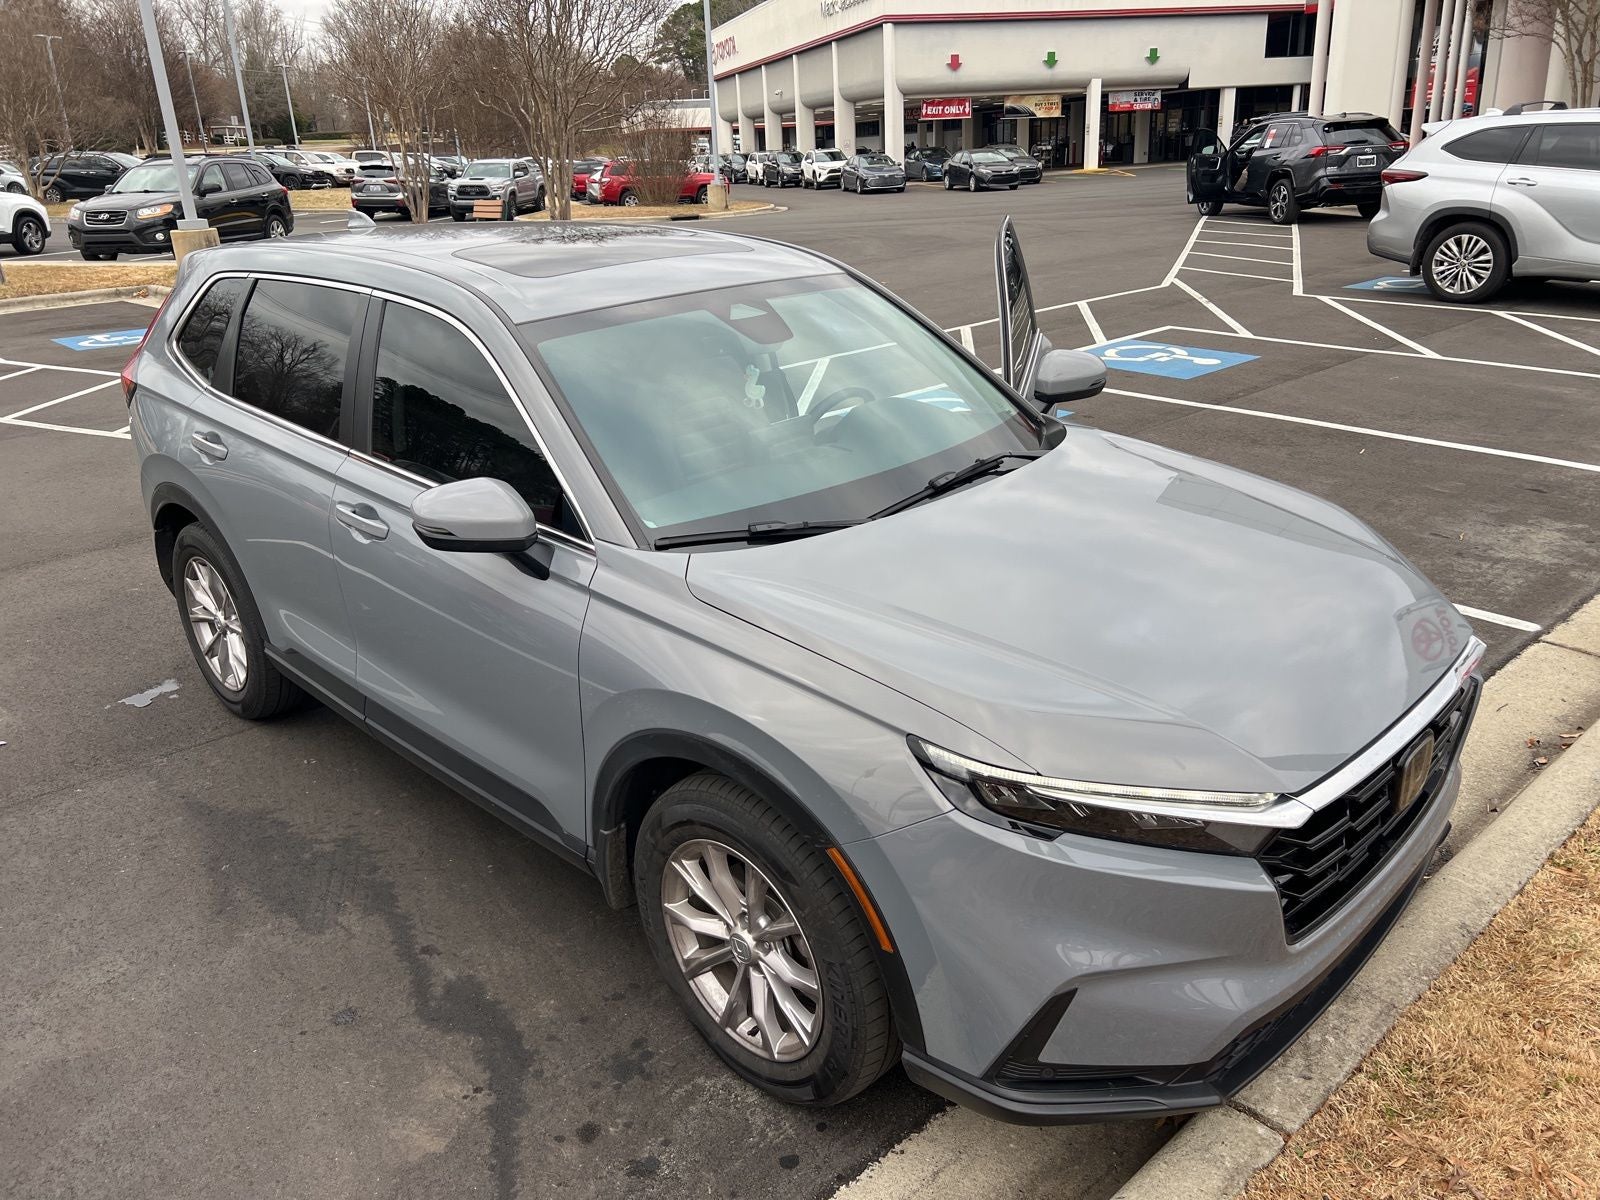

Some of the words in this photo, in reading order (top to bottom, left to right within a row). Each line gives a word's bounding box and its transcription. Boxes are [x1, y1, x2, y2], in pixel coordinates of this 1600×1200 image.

[716, 36, 737, 61] TOYOTA
[927, 106, 943, 114] EXIT
[944, 105, 965, 113] ONLY
